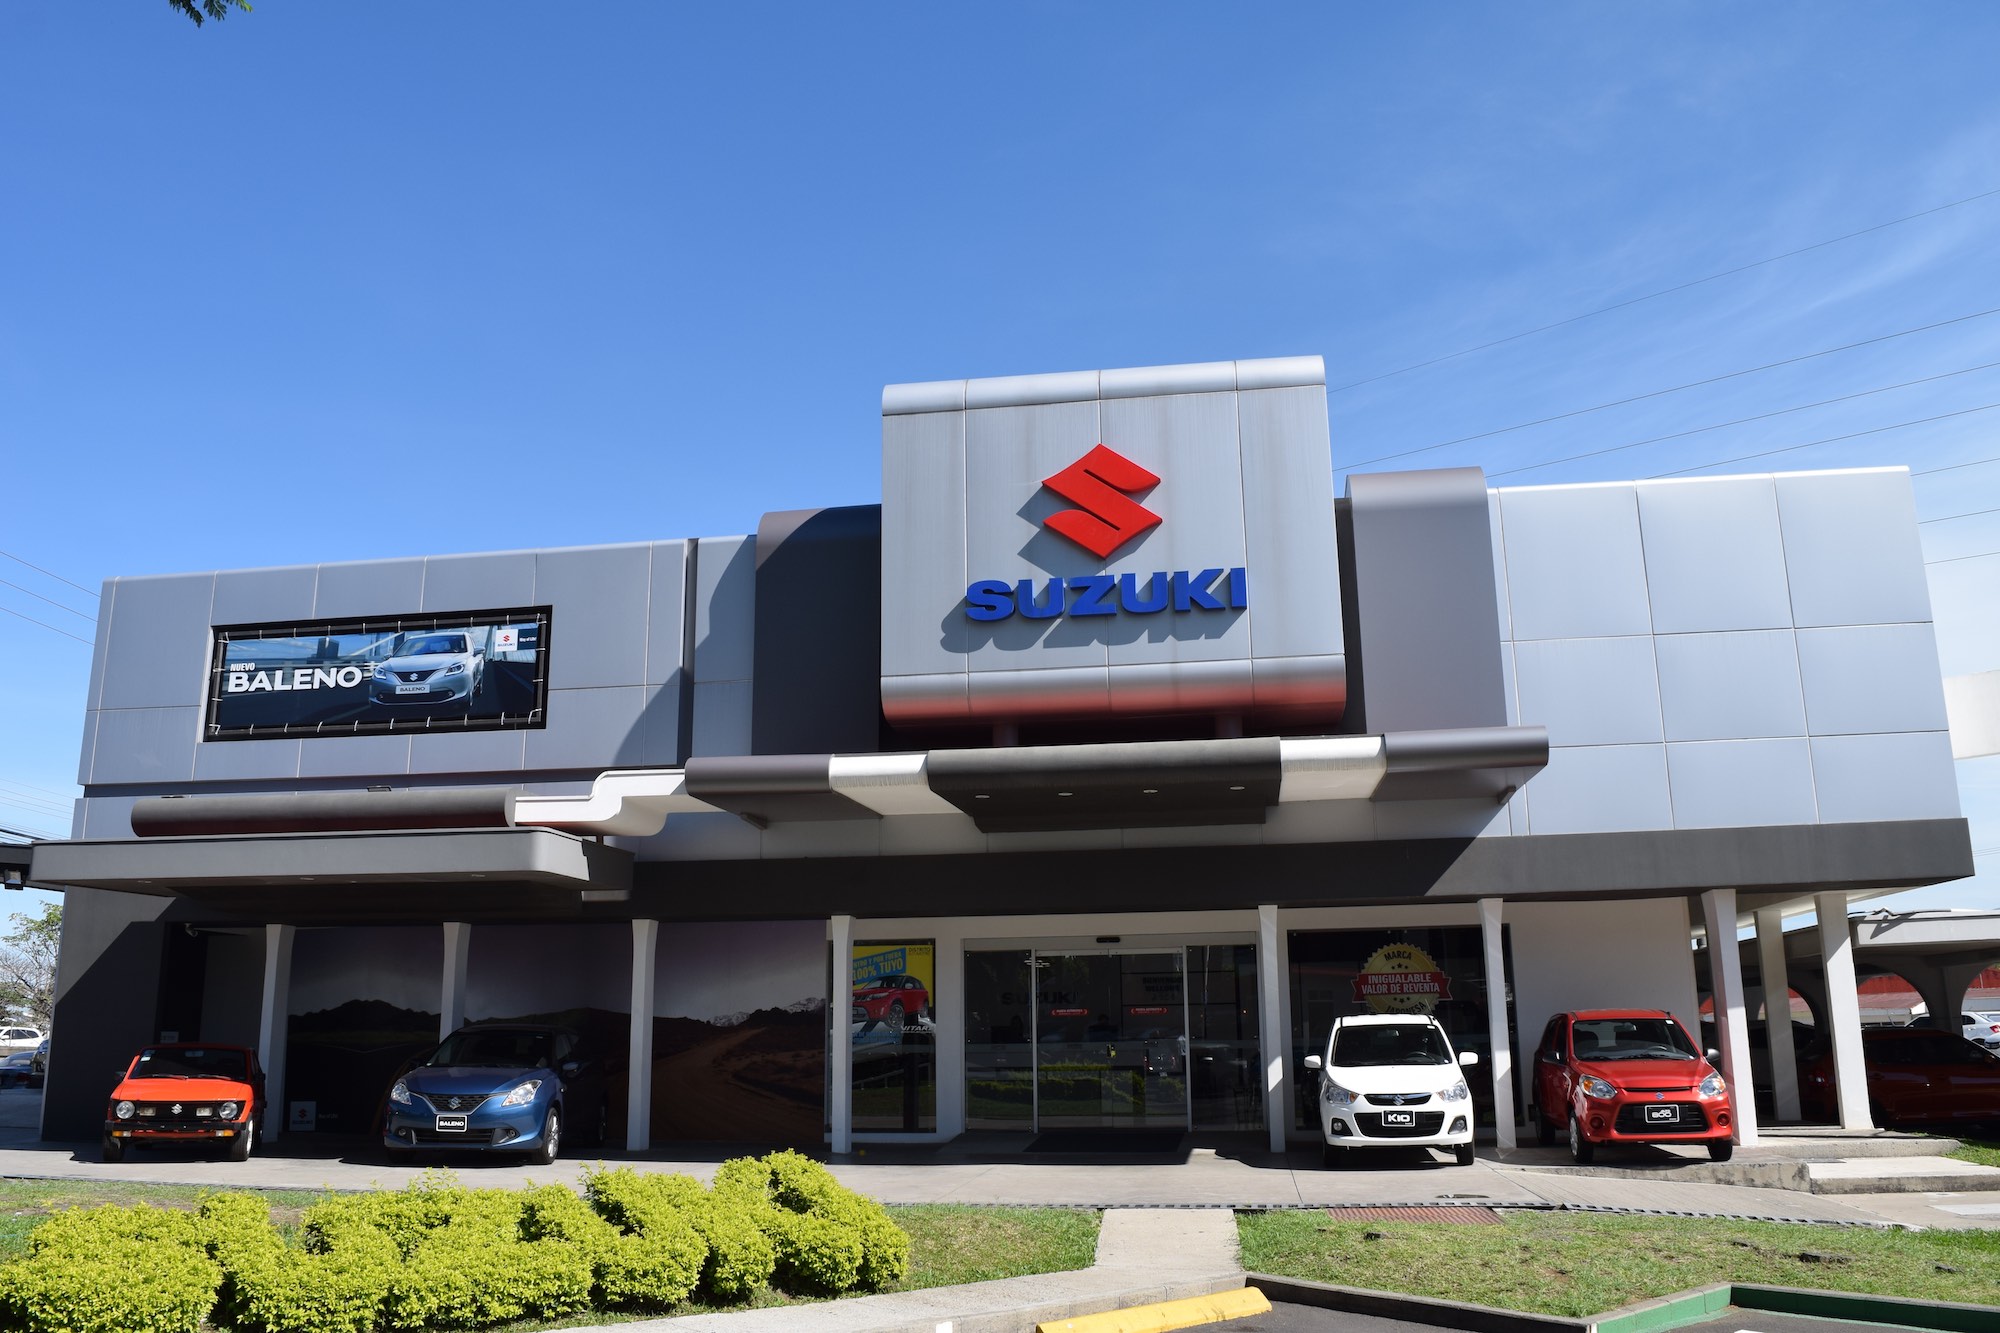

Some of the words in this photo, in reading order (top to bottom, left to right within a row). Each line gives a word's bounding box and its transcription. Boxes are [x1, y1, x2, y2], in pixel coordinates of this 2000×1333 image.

[965, 567, 1247, 622] SUZUKI
[230, 662, 255, 671] NUEVO
[227, 666, 363, 693] BALENO
[1384, 950, 1412, 961] MARCA
[880, 958, 903, 974] TUYO
[1368, 974, 1431, 984] INIGUALABLE
[1361, 984, 1388, 994] VALOR
[1390, 984, 1401, 993] DE
[1403, 983, 1440, 993] REVENTA
[1001, 991, 1080, 1005] SUUKI
